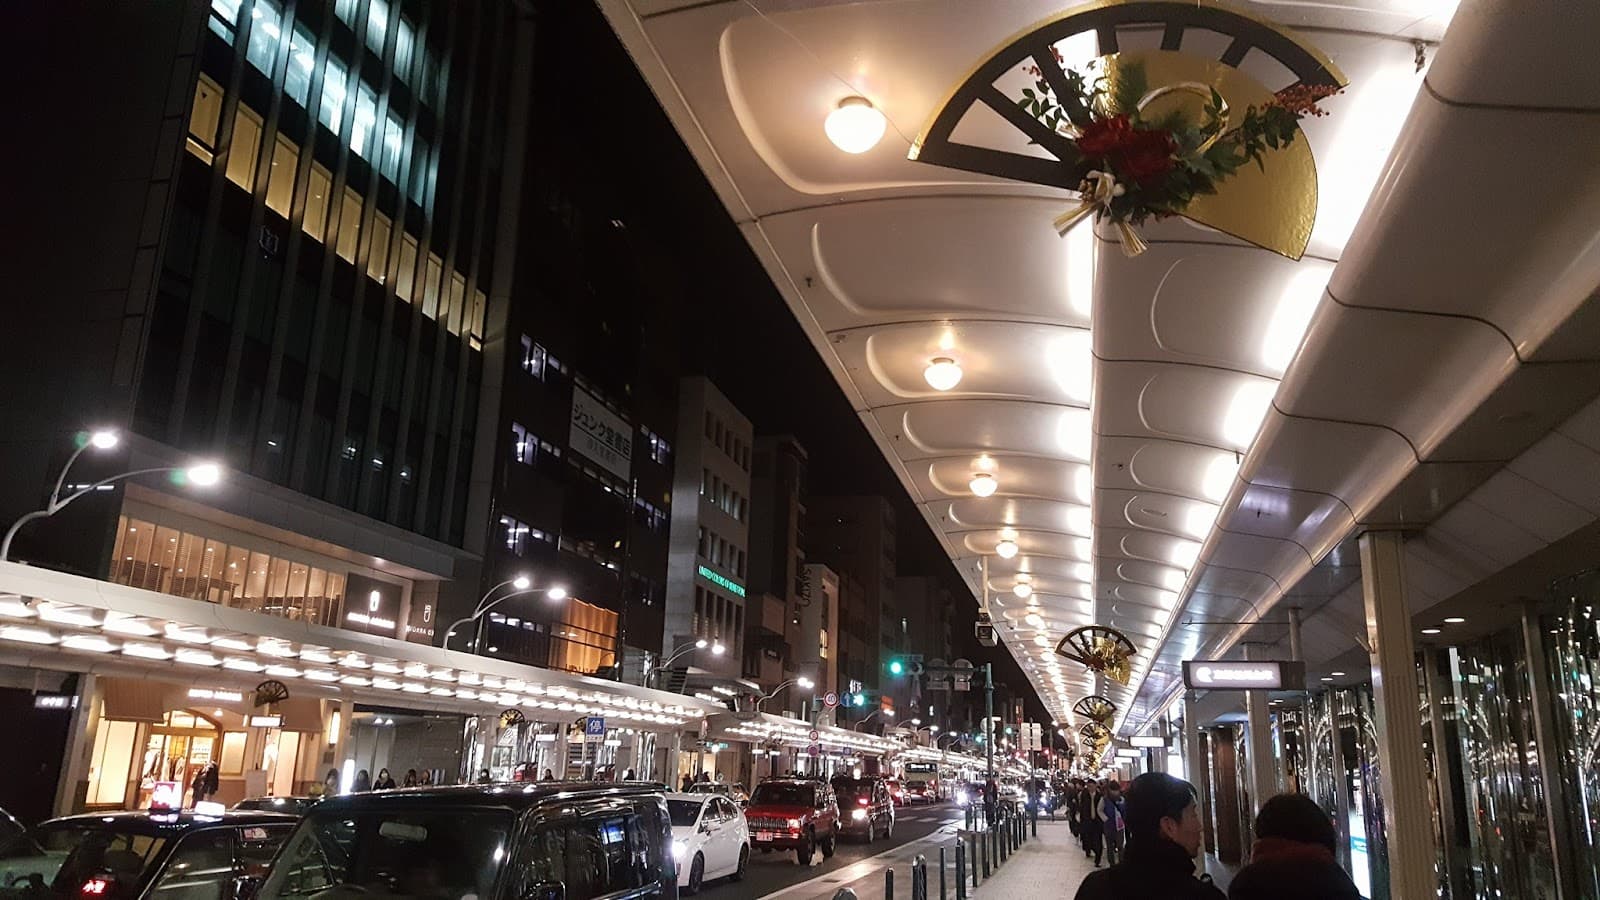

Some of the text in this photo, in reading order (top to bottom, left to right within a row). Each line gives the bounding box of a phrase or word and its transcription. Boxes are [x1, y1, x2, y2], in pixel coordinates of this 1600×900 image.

[574, 403, 631, 456] ジュンク堂書店
[698, 564, 712, 580] UNITED
[712, 572, 724, 587] COLORS
[729, 582, 746, 598] BENETTON
[588, 719, 602, 733] 停
